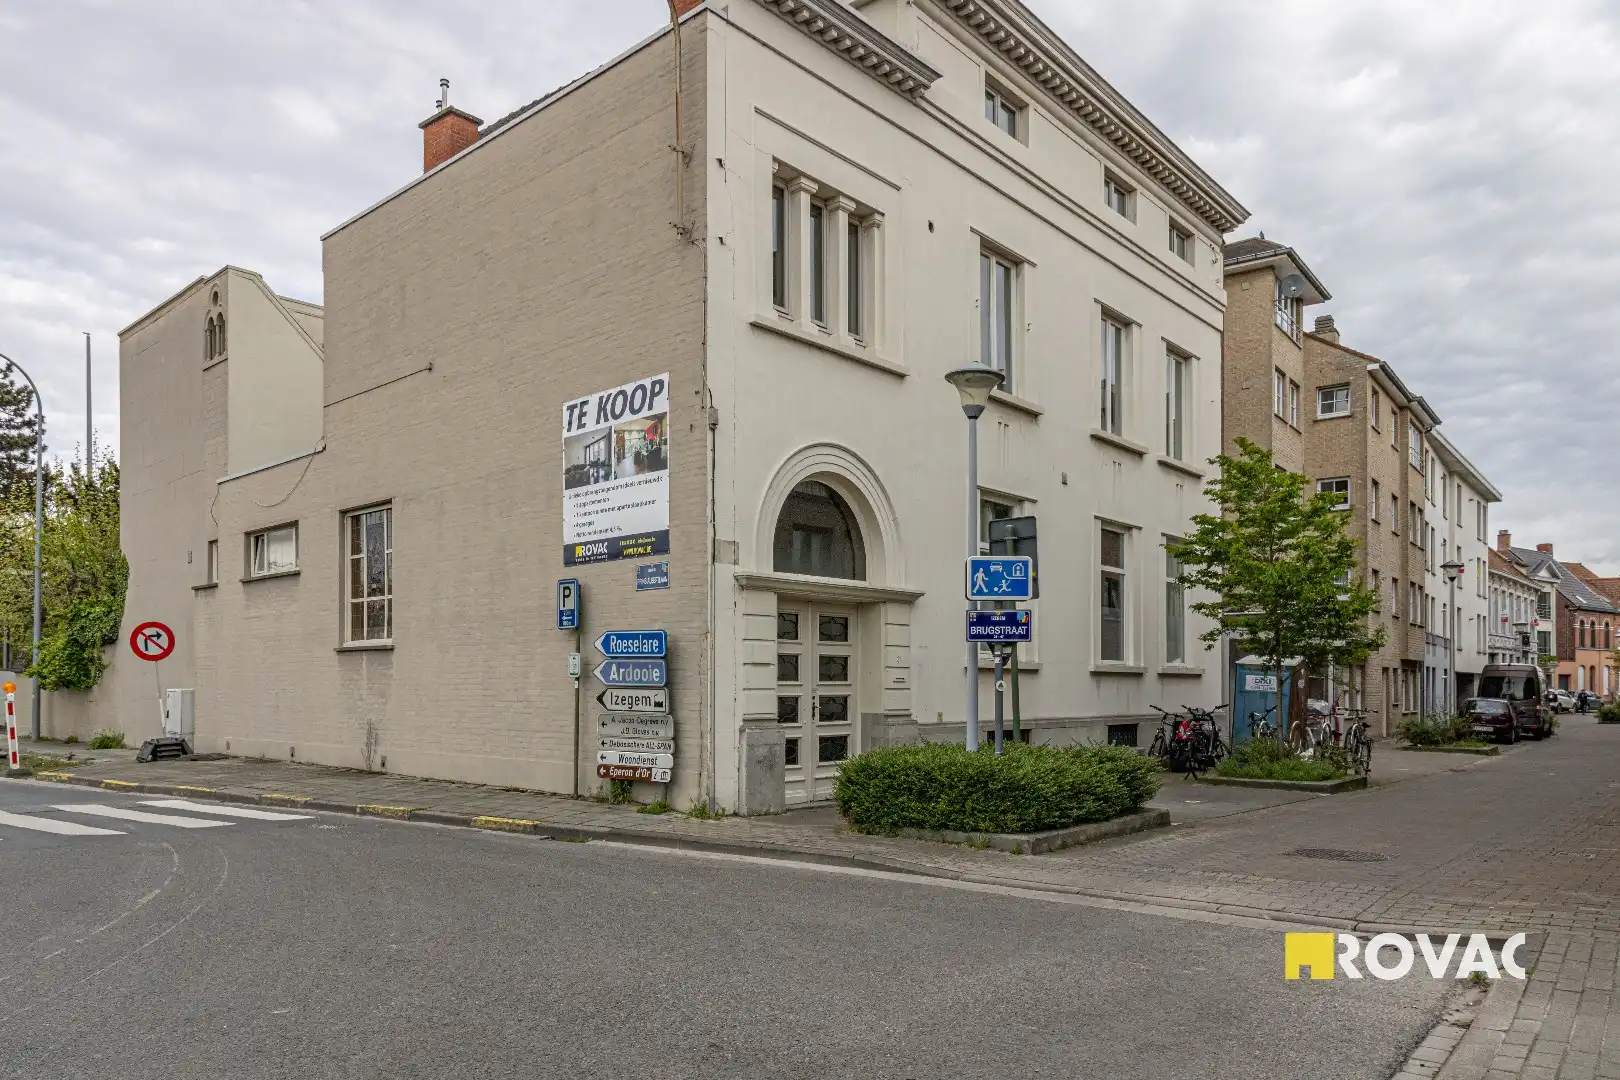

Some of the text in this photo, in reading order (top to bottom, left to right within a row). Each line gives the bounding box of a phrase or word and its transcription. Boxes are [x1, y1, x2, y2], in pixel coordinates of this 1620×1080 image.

[566, 378, 664, 432] TE KOOP
[581, 542, 608, 555] ROVAC
[562, 586, 572, 608] P
[970, 626, 1027, 635] BRUGSTRAAT
[610, 635, 659, 653] Roeselare
[610, 664, 660, 682] Ardooie
[610, 692, 651, 710] Izegem
[619, 754, 658, 766] Woondienst
[636, 768, 651, 778] d'Or
